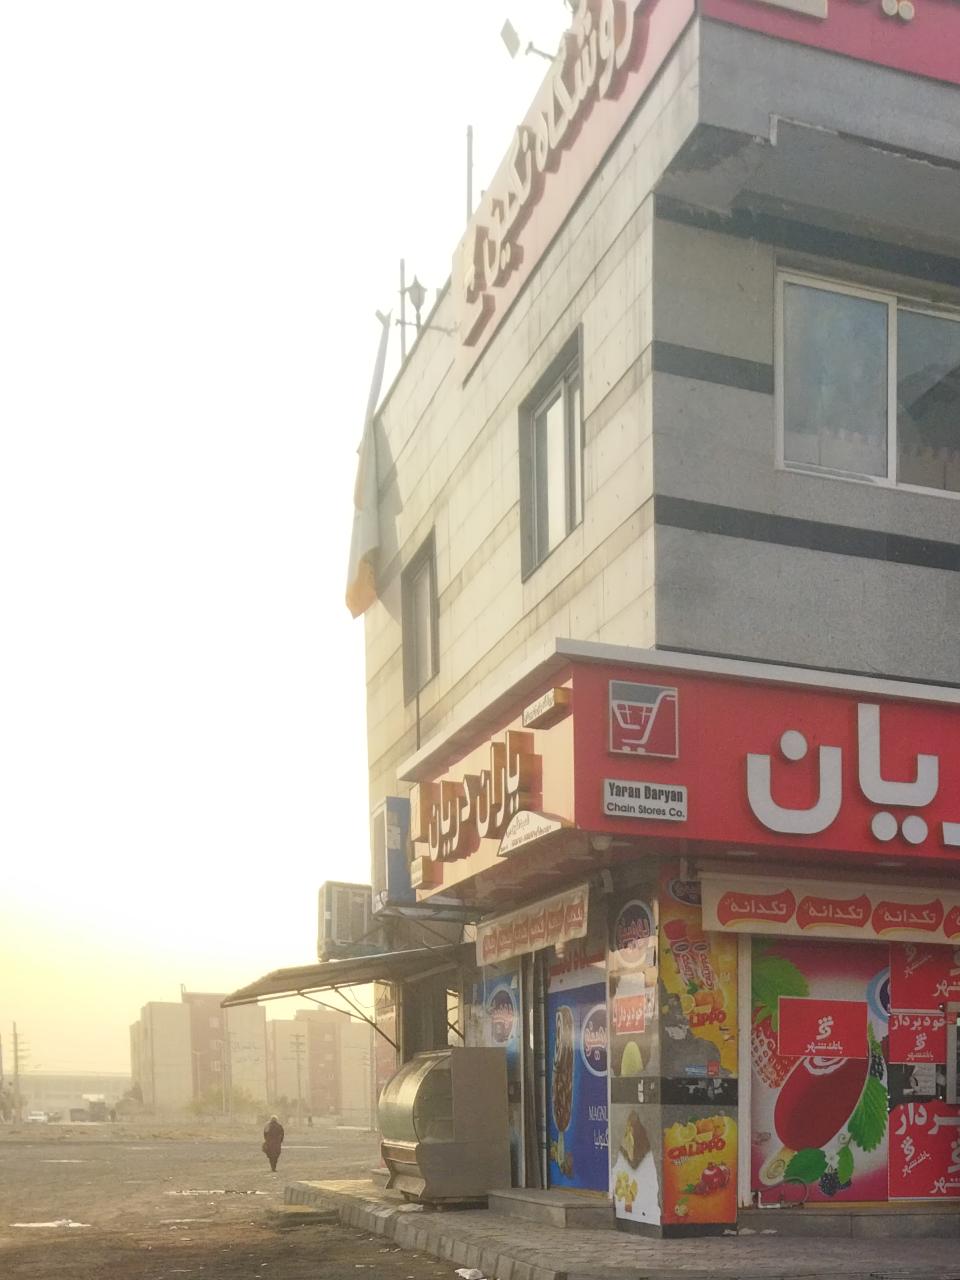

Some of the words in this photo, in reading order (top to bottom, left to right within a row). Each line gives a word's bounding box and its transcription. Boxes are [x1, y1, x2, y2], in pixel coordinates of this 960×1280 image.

[477, 731, 520, 838] یاران
[608, 782, 641, 801] Yaran
[644, 785, 684, 804] Daryan
[429, 774, 471, 862] دریان
[606, 803, 636, 816] Chain
[638, 805, 668, 817] Stores
[669, 807, 686, 819] Co.
[667, 1137, 726, 1160] CALIPPO
